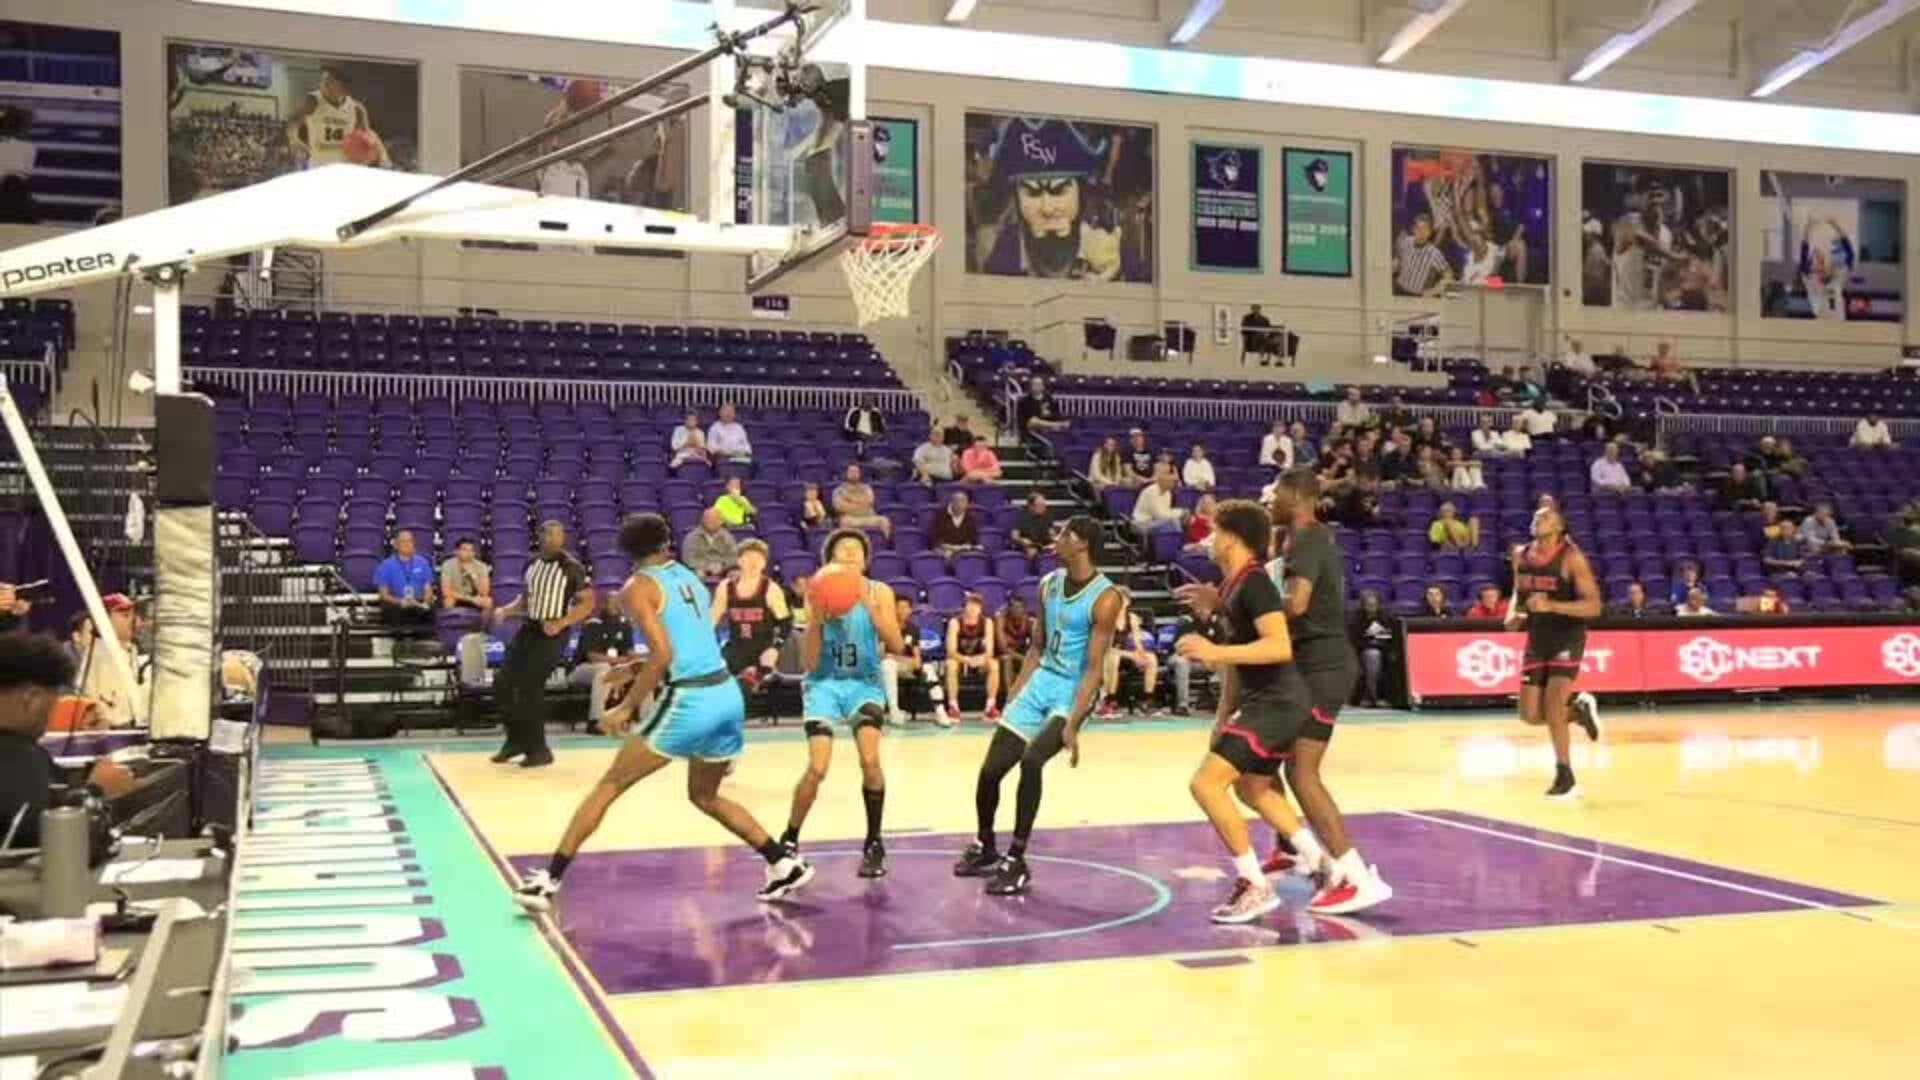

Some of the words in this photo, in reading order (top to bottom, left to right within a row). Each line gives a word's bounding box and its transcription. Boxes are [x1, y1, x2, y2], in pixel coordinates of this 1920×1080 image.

[1021, 133, 1057, 165] FSW
[678, 584, 702, 620] 4
[831, 642, 858, 668] 43
[1050, 629, 1062, 655] 0
[1736, 644, 1824, 671] NEXT
